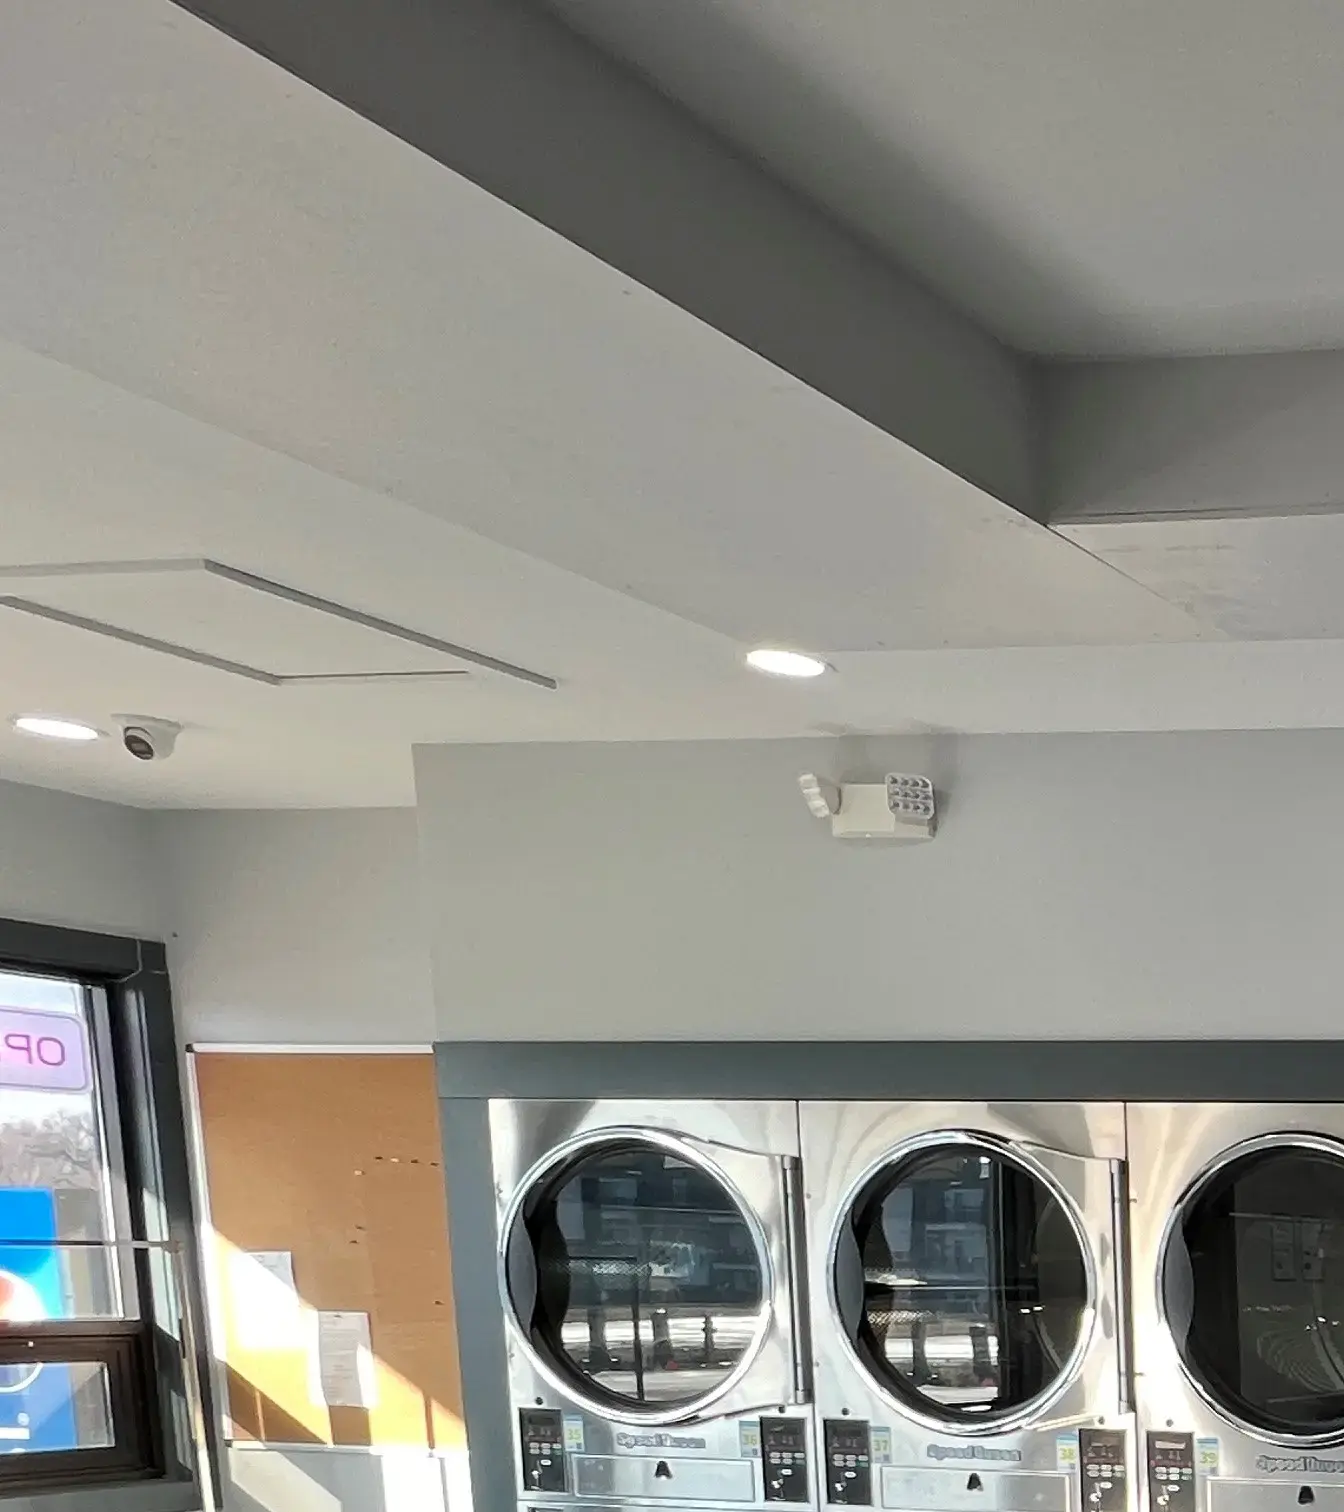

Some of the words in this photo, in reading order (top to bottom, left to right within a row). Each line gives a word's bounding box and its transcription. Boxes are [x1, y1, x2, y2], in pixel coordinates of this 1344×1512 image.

[566, 1428, 581, 1441] 35
[873, 1439, 888, 1451] 37
[1200, 1452, 1217, 1464] 39
